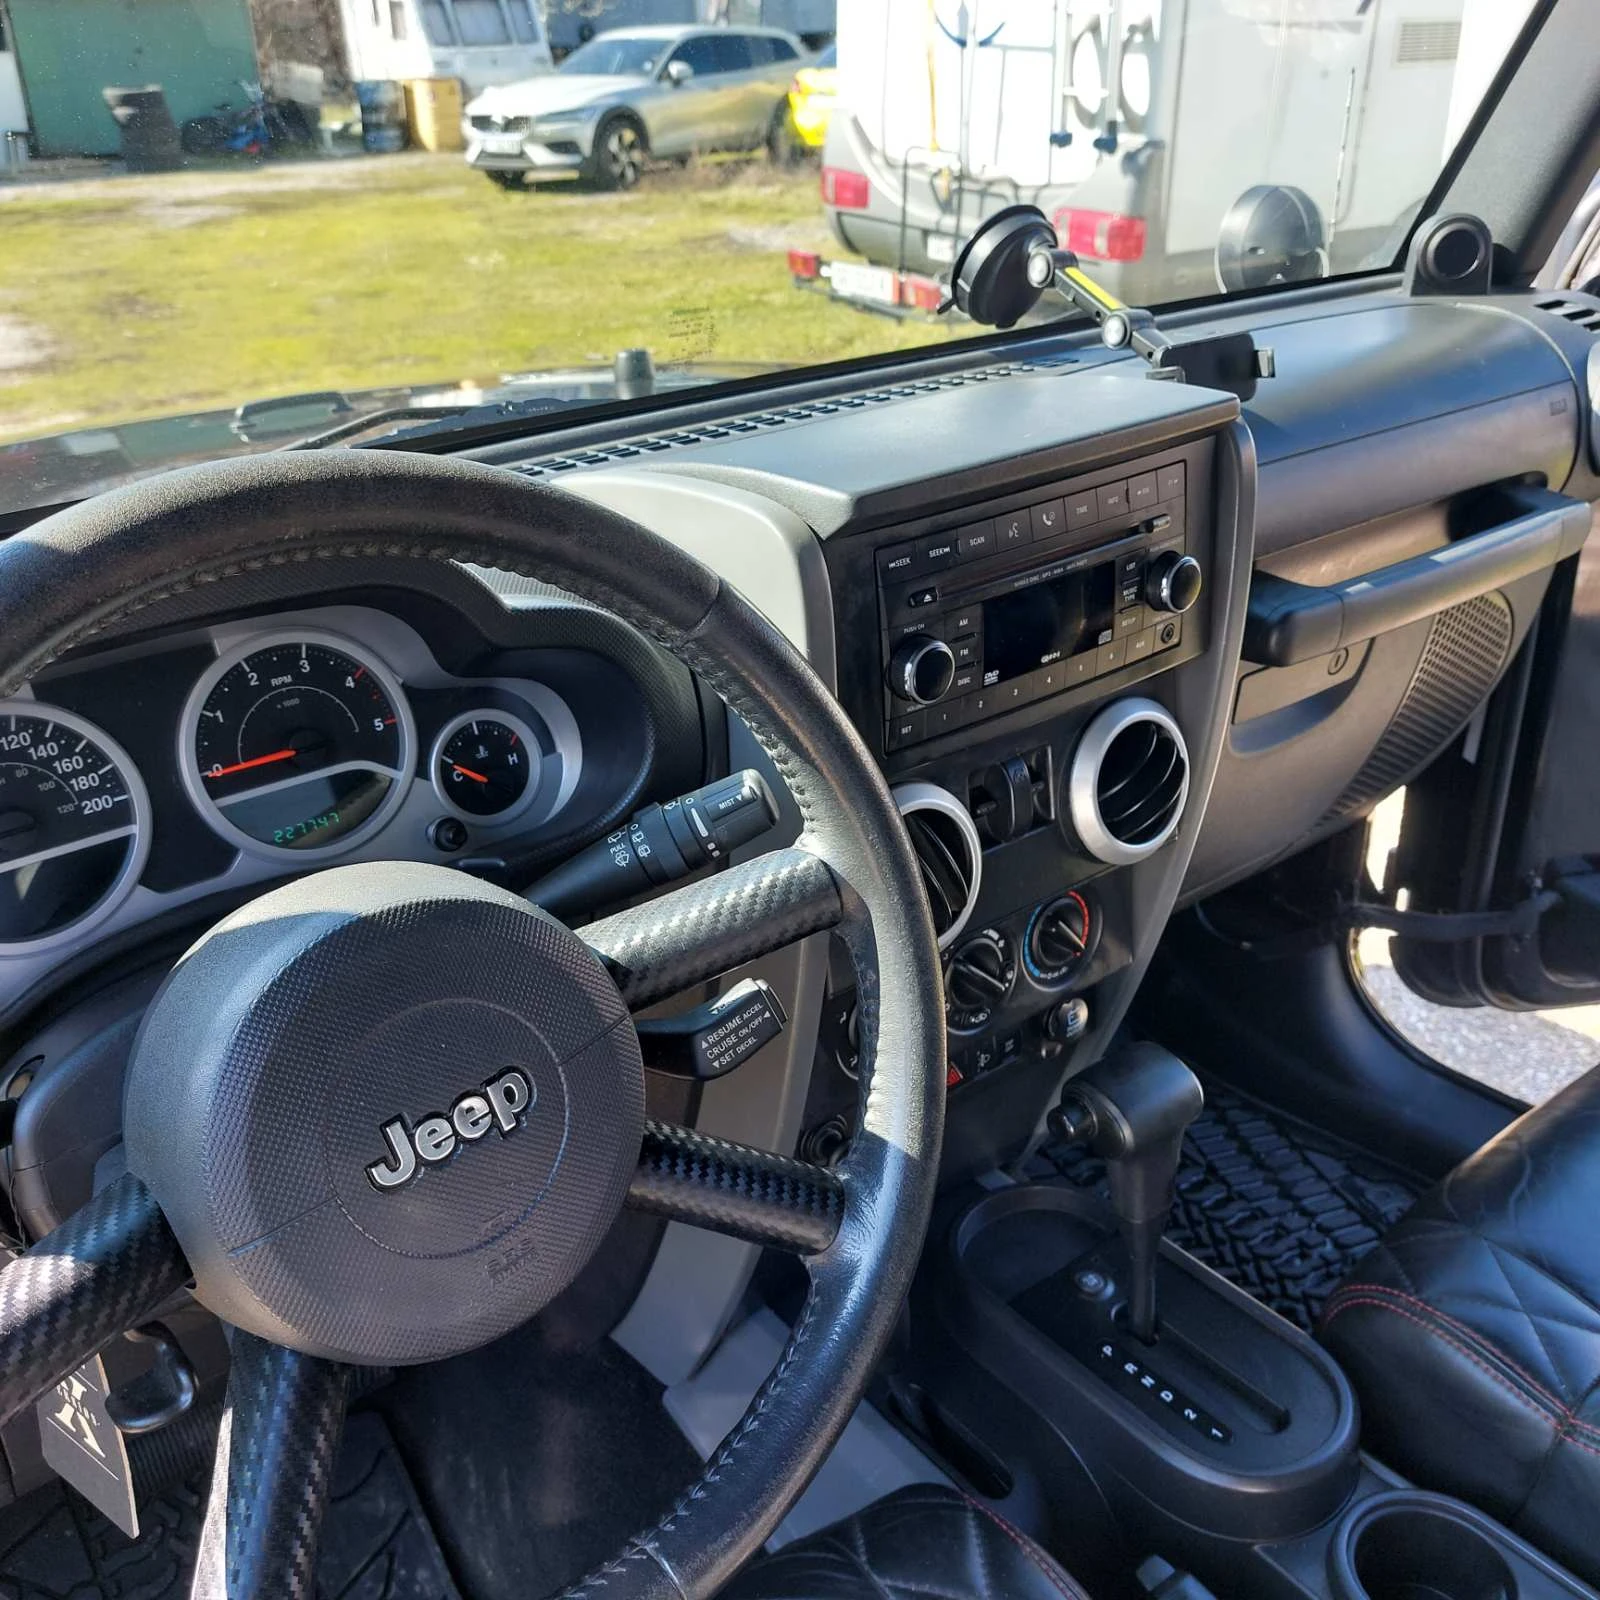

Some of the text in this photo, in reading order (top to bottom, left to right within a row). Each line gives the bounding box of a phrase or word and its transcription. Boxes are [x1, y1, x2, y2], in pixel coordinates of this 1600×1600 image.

[969, 536, 985, 546] SCAN
[929, 548, 943, 558] SEEK
[895, 557, 911, 567] SEEK
[959, 618, 969, 627] AM
[960, 648, 969, 656] FM
[299, 659, 310, 673] 3
[248, 672, 260, 686] 2
[270, 675, 293, 687] RPM
[345, 676, 355, 689] 4
[215, 710, 224, 723] 1
[373, 718, 384, 731] 5
[901, 725, 913, 735] SET
[0, 732, 31, 751] 120
[27, 742, 59, 760] 140
[52, 755, 84, 774] 160
[508, 753, 519, 766] H
[69, 772, 100, 792] 180
[452, 771, 464, 782] C
[81, 795, 113, 815] 200
[719, 797, 735, 811] MIST
[274, 812, 341, 843] 227747
[610, 843, 626, 855] PULL
[707, 1016, 743, 1044] RESUME
[743, 1003, 764, 1019] ACCEL
[707, 1016, 762, 1059] CRUISE ON/OFF
[720, 1037, 758, 1065] SET DECEL
[368, 1068, 534, 1190] Jeep
[1102, 1345, 1223, 1438] P R N D 2 1
